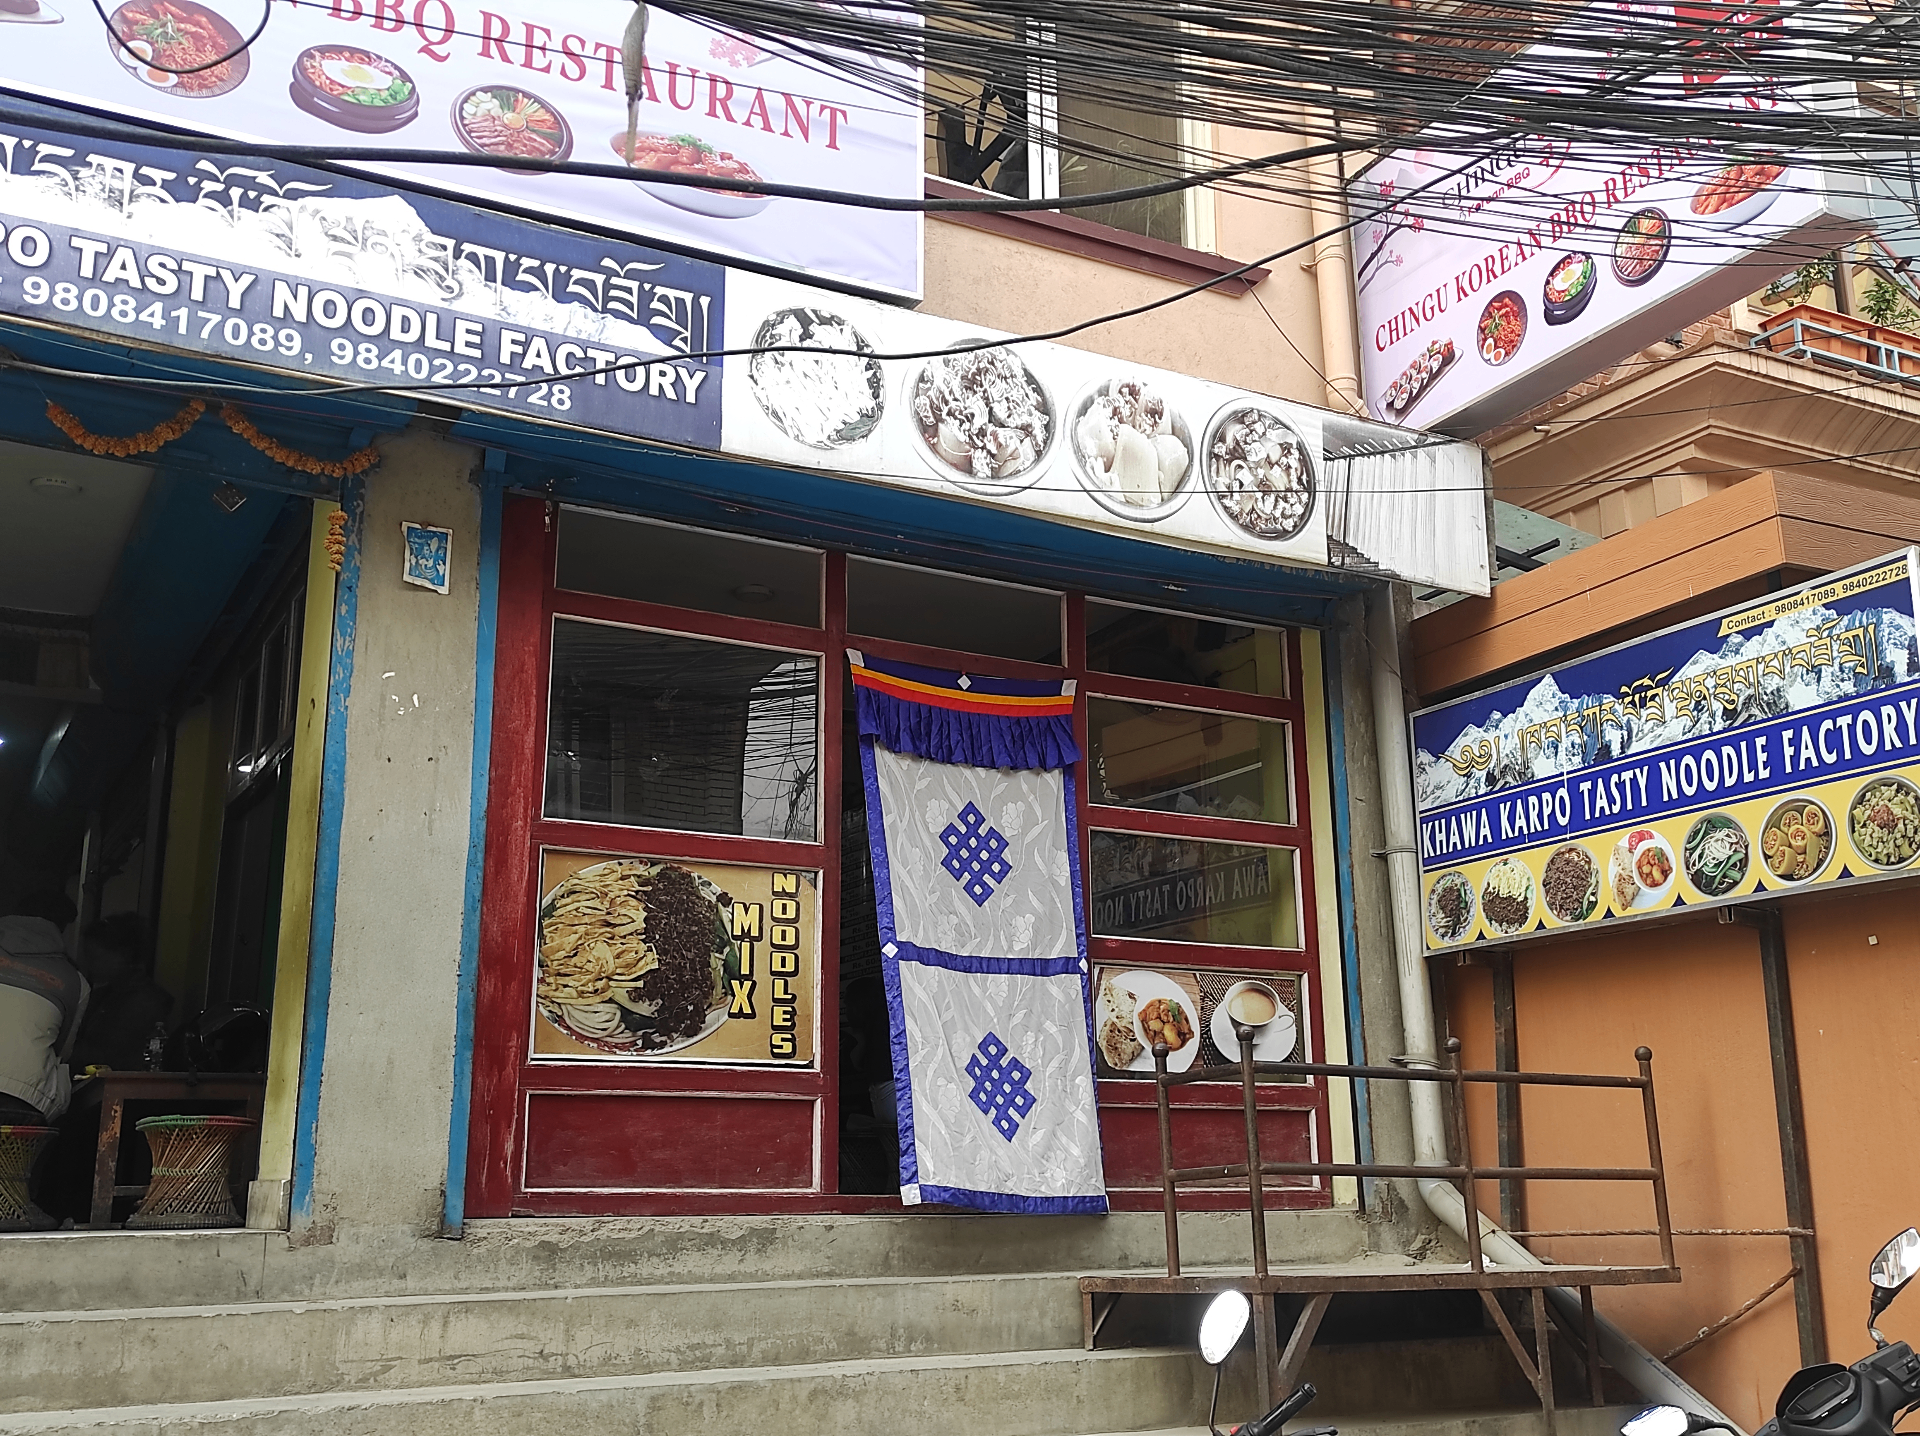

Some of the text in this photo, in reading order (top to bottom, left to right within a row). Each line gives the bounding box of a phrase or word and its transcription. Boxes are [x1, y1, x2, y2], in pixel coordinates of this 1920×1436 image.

[477, 9, 848, 151] RESTAURANT
[1506, 166, 1531, 190] BBQ
[0, 220, 708, 405] O TASTY NOODLE FACTORY
[22, 275, 572, 411] 9808417089, 9840222728
[1375, 284, 1450, 353] CHINGU
[1454, 222, 1545, 304] KOREAN
[1549, 191, 1597, 244] BBQ
[1726, 611, 1766, 630] Contact
[1774, 588, 1839, 615] 9808417089,
[1842, 564, 1908, 594] 9840222728
[1422, 698, 1919, 859] KHAWA KARPO TASTY NOODLE FACTORY
[728, 902, 763, 1018] MIX
[769, 871, 800, 1059] NOODLES
